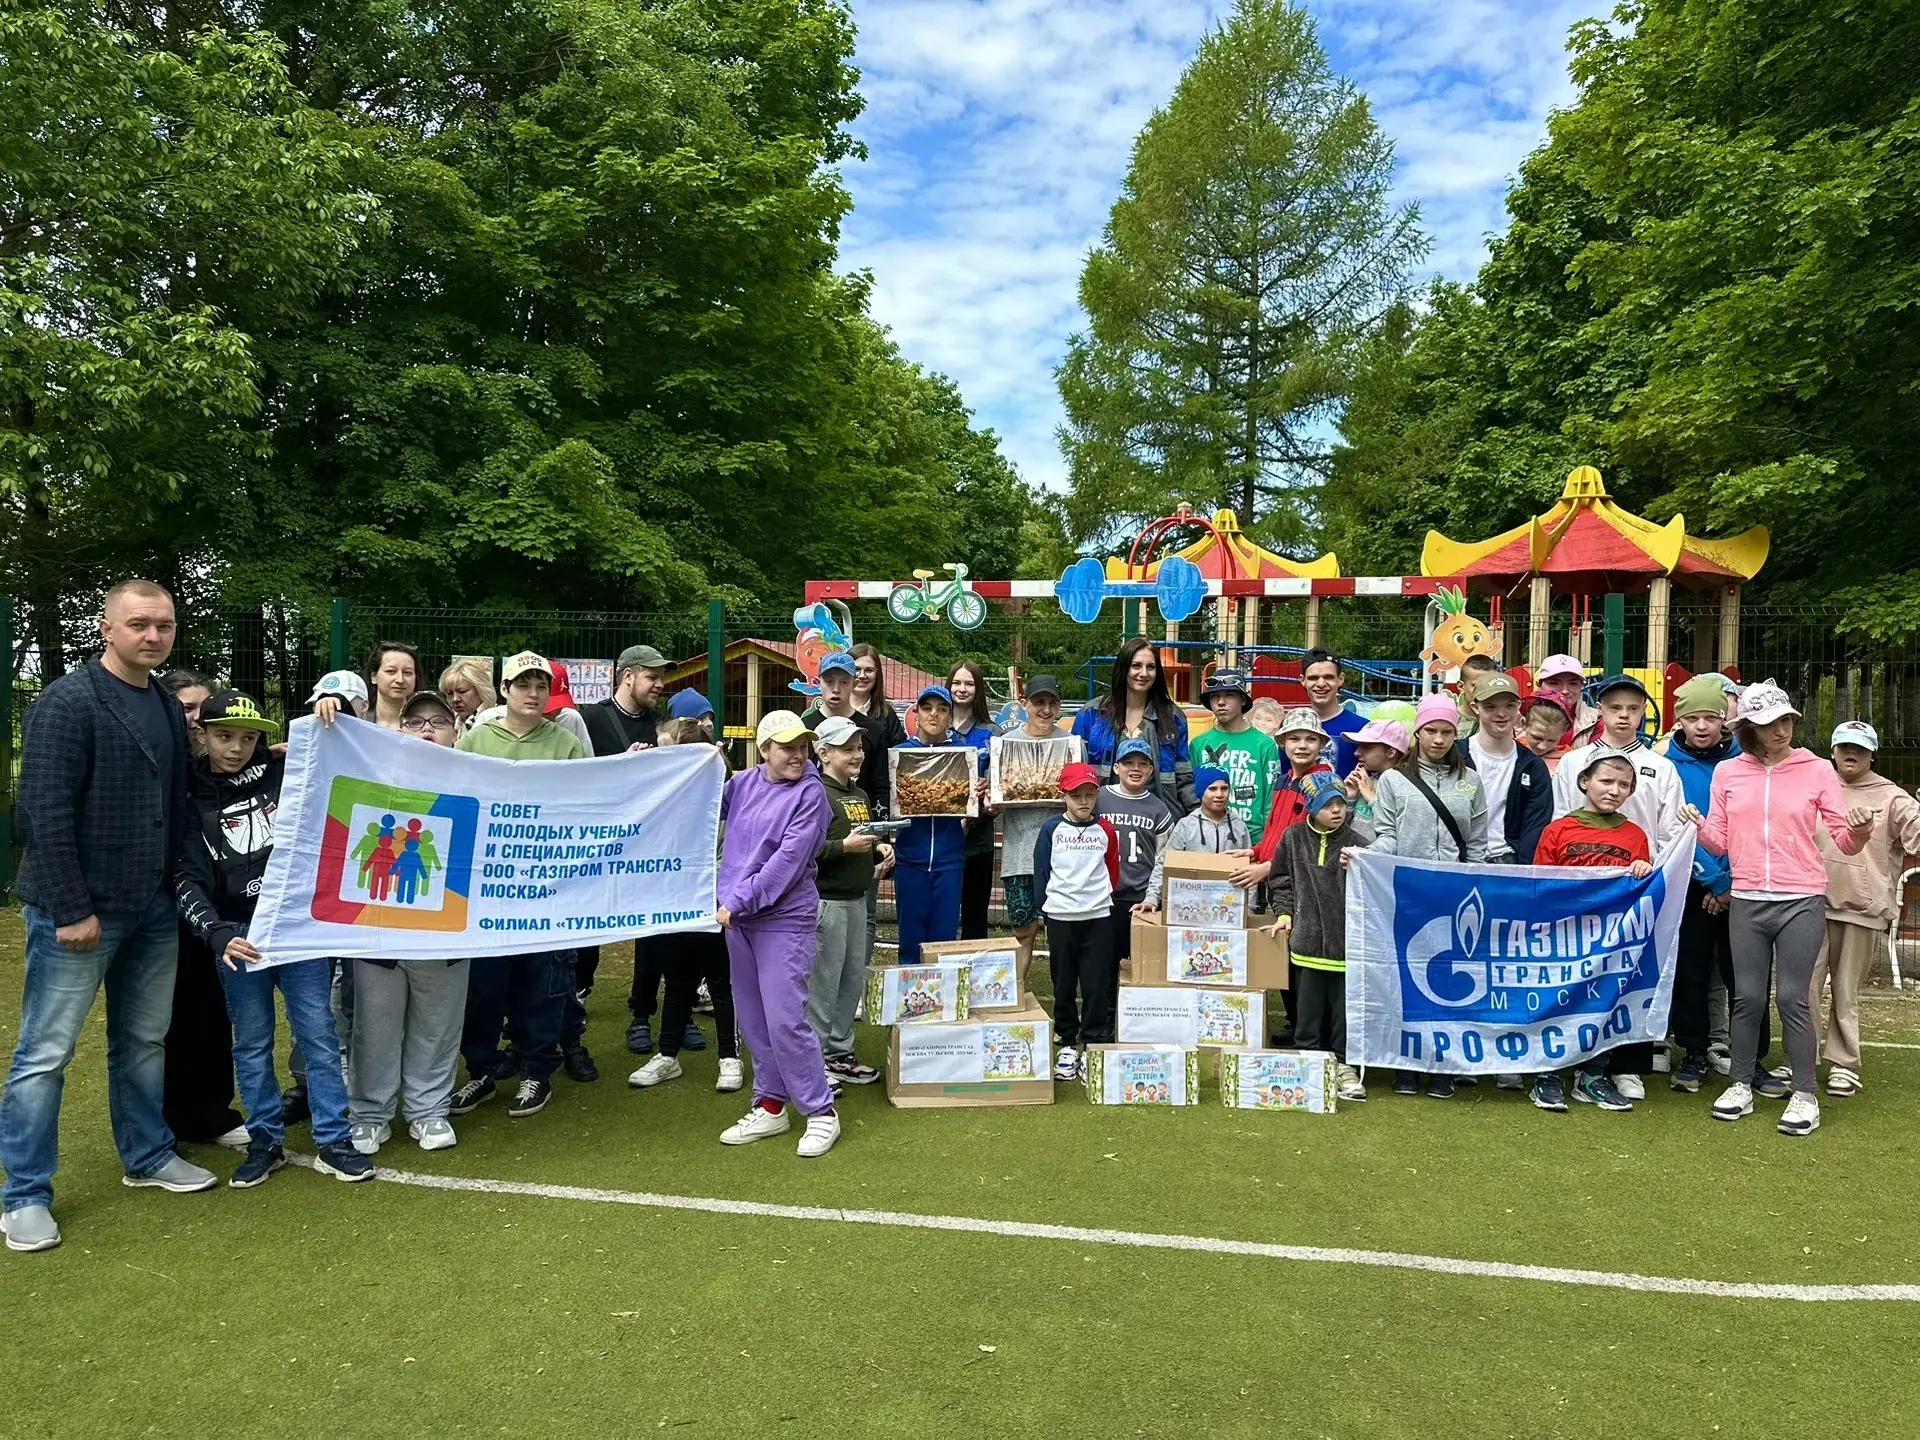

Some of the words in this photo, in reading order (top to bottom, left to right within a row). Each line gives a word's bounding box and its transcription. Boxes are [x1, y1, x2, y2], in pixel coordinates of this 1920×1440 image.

[517, 655, 542, 663] GOOD
[518, 660, 543, 668] LUCK
[490, 802, 542, 819] СОВЕТ
[487, 822, 573, 842] МОЛОДЫХ
[578, 823, 643, 841] УЧЕНЫХ
[485, 843, 497, 858] И
[500, 842, 624, 862] СПЕЦИАЛИСТОВ
[482, 863, 515, 879] ООО
[519, 862, 603, 880] «ГАЗПРОМ
[607, 857, 683, 875] ТРАНСГАЗ
[480, 883, 558, 899] МОСКВА»
[1179, 882, 1202, 892] ИЮНЯ
[478, 916, 551, 931] ФИЛИАЛ
[555, 913, 646, 930] «ТУЛЬСКОЕ
[650, 910, 712, 925] ЛПУМГ
[1489, 894, 1656, 958] ГАЗПРОМ
[1494, 949, 1635, 985] ТРАНСГА
[1400, 997, 1653, 1063] ПРОФСОЮ
